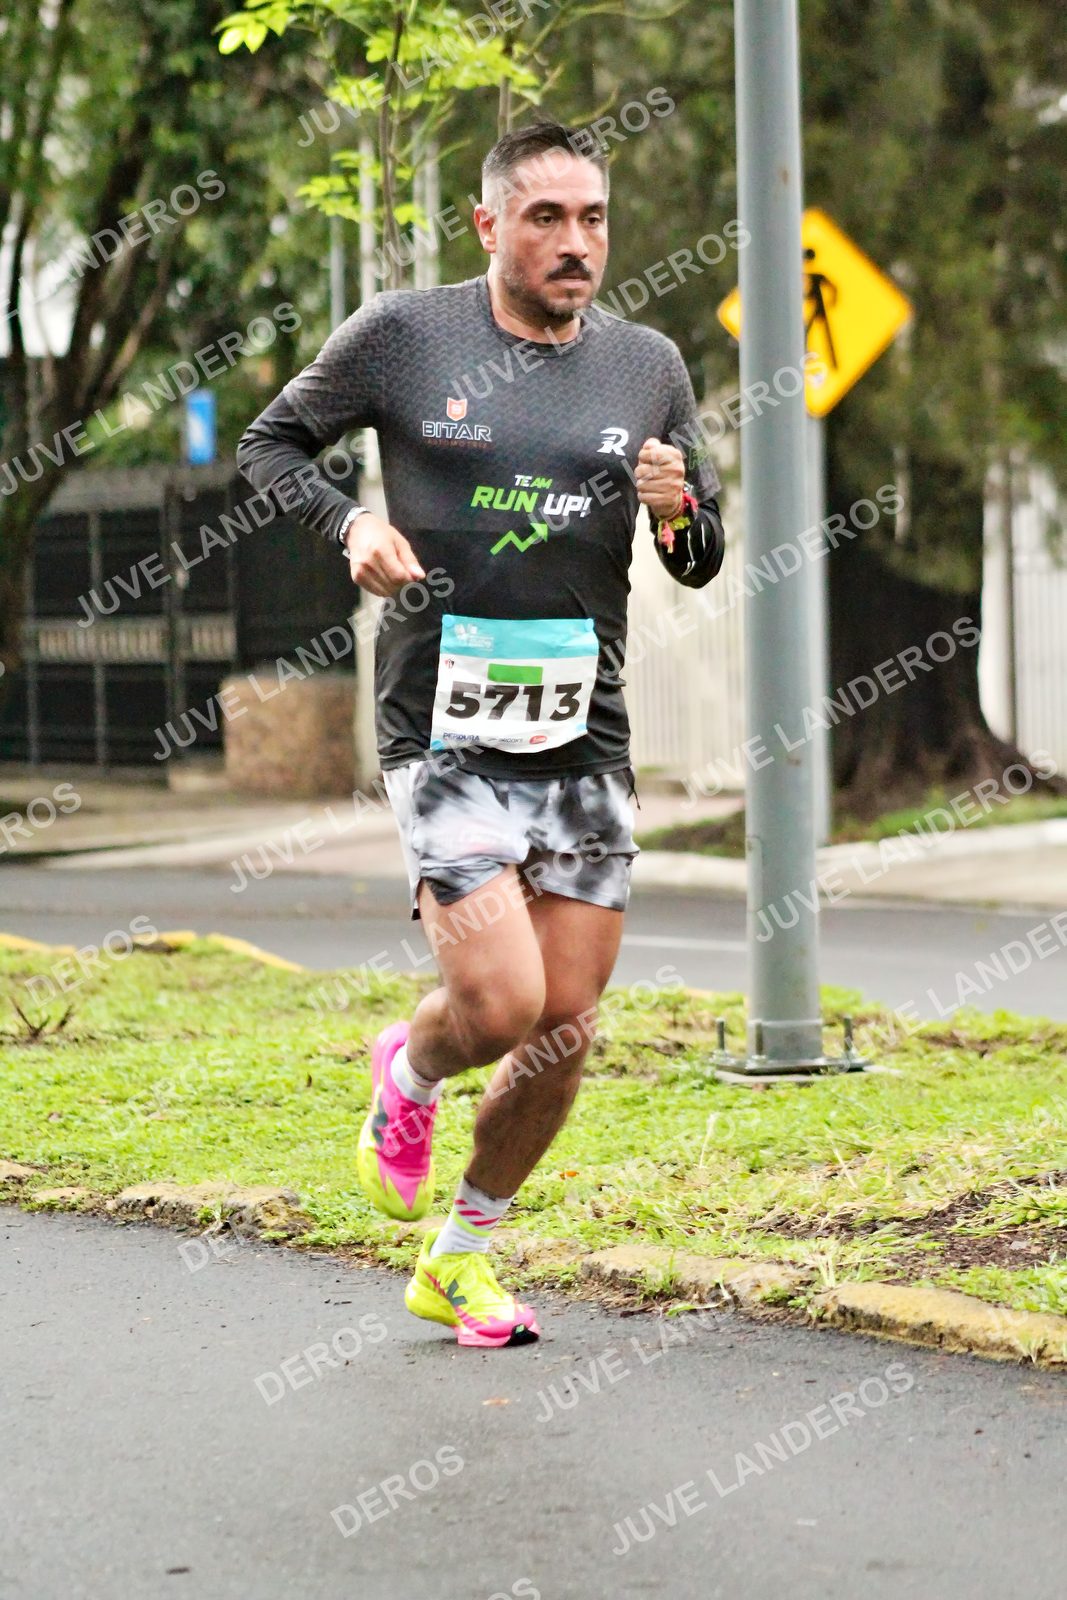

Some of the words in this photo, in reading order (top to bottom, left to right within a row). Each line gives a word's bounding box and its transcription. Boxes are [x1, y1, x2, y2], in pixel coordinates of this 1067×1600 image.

[422, 420, 492, 442] BITAR
[514, 474, 553, 489] TEAM
[470, 486, 539, 513] RUN
[543, 493, 592, 518] UP!
[445, 681, 582, 721] 5713
